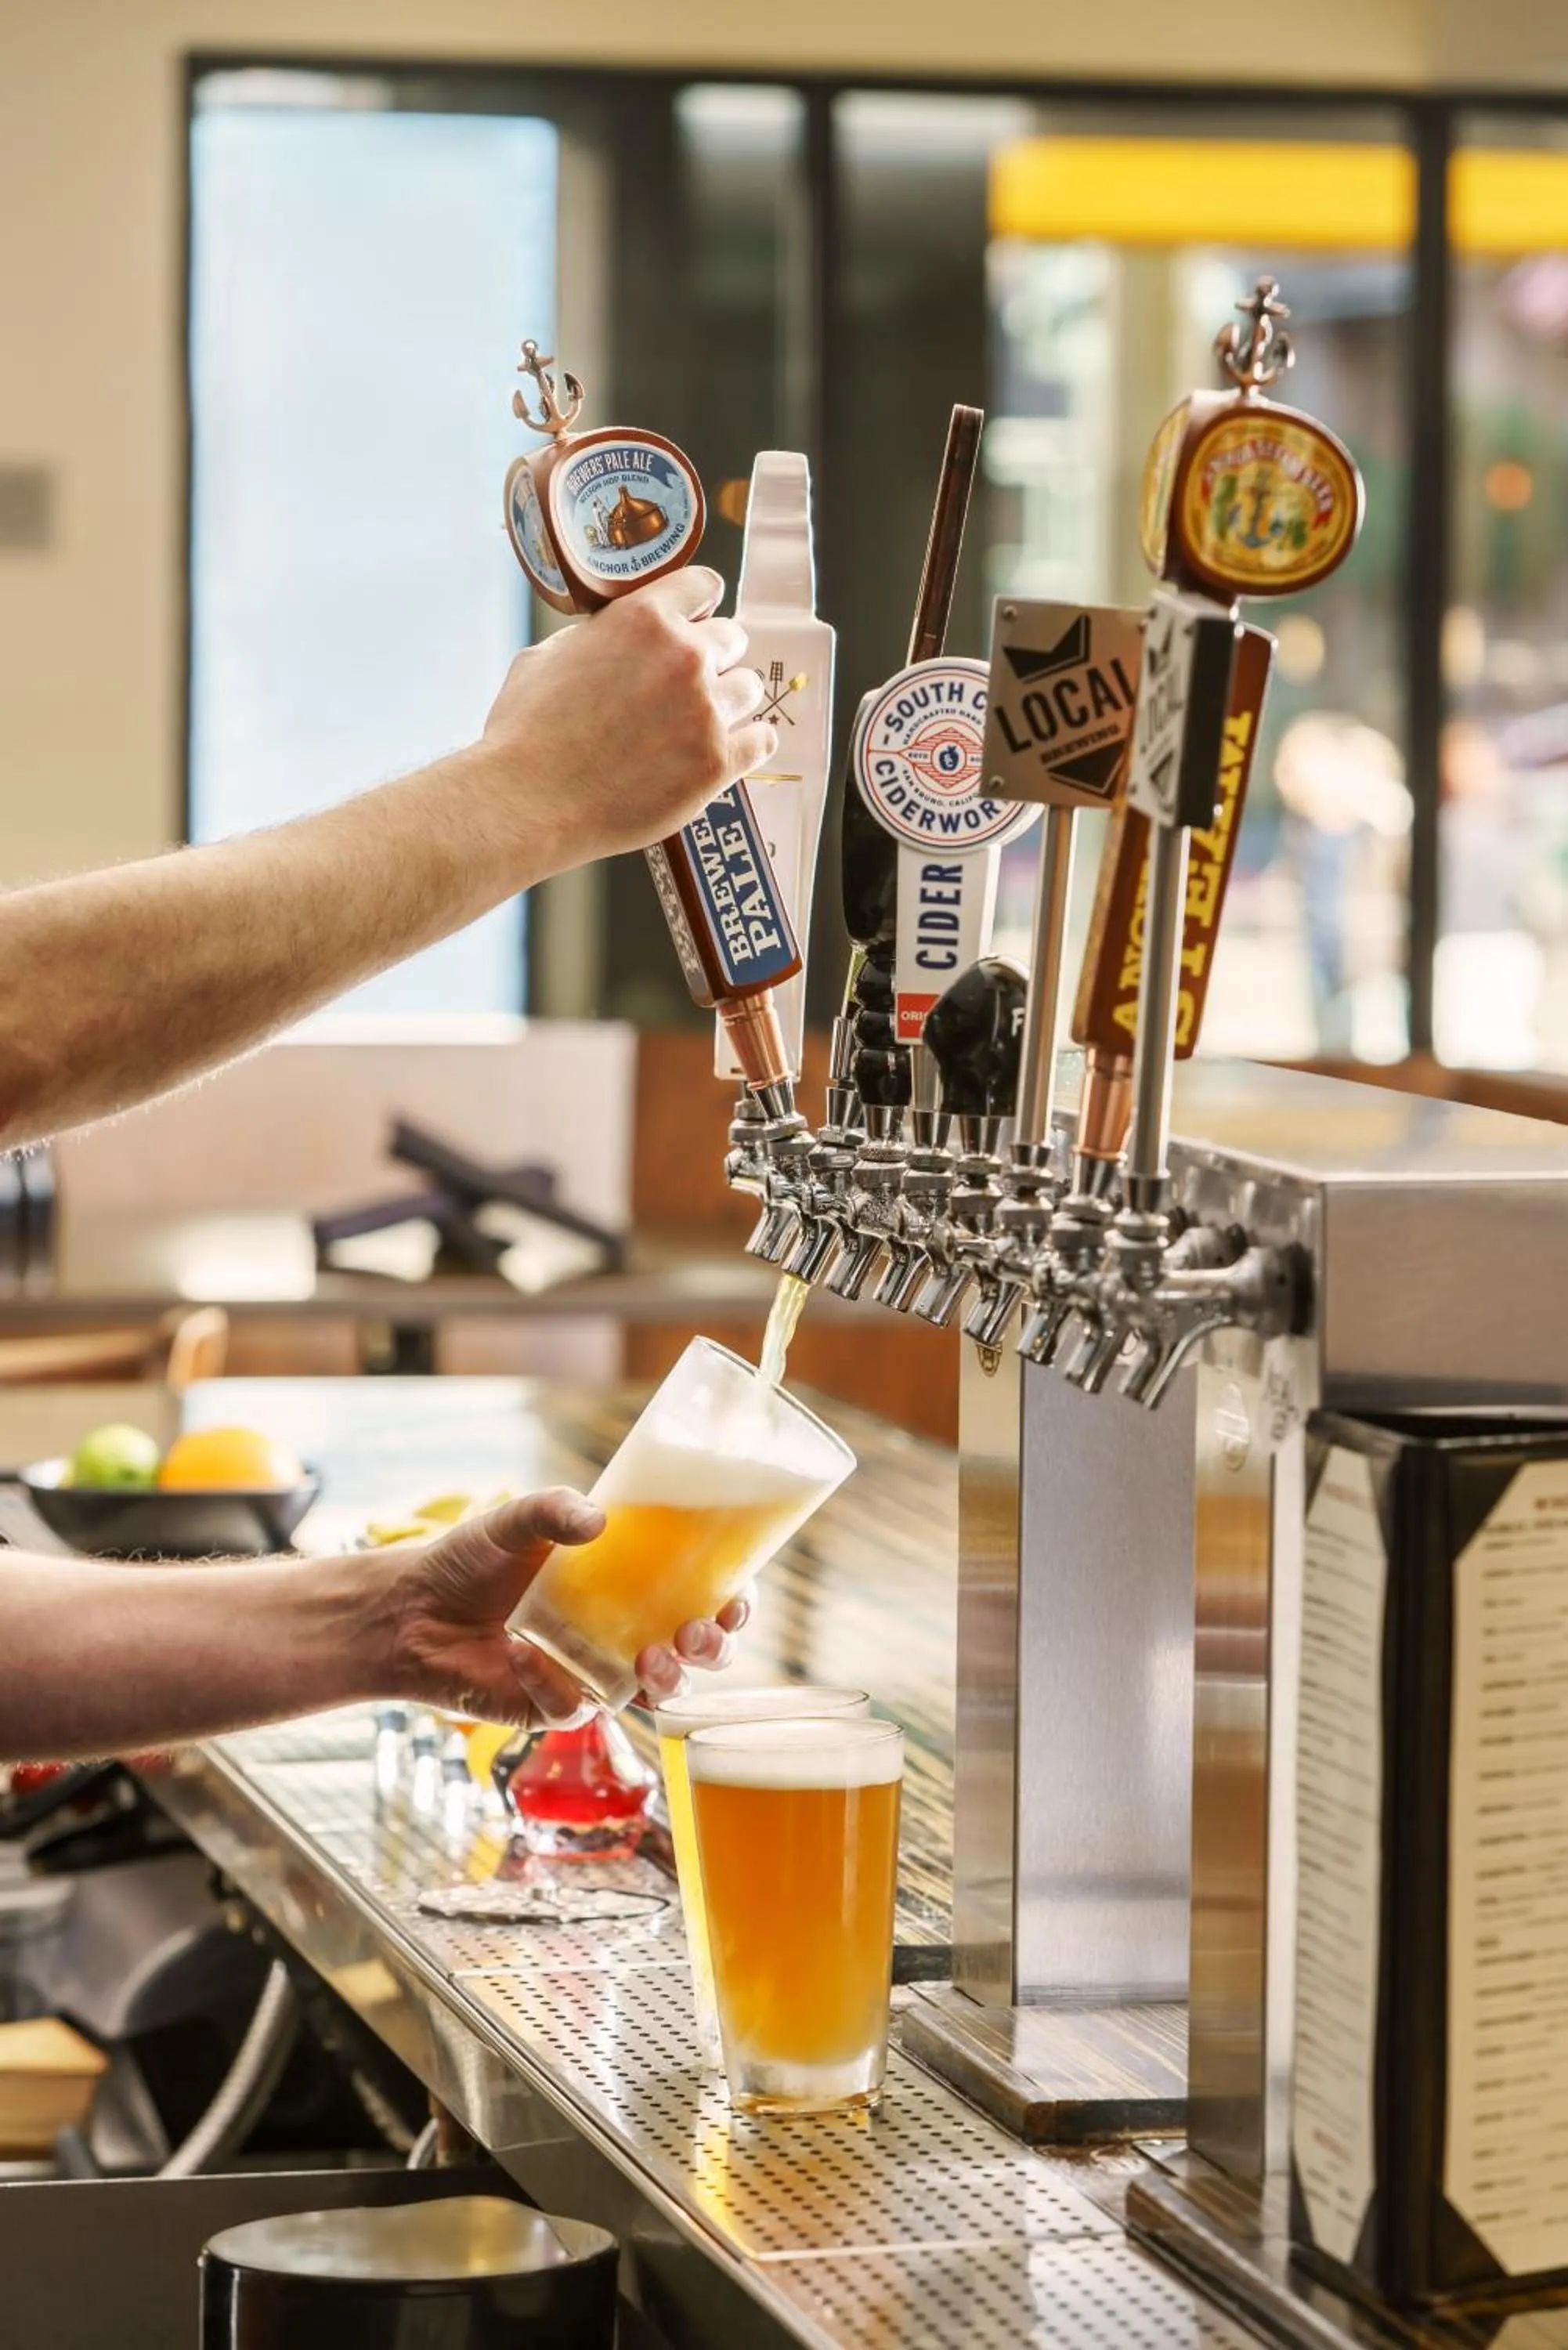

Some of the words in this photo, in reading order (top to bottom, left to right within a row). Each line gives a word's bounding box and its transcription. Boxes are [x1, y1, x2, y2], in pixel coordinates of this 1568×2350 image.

[604, 450, 631, 472] PALE
[632, 450, 655, 472] ALE
[640, 522, 686, 566] BREWING
[883, 681, 965, 733] SOUTH
[875, 758, 1010, 834] CIDERWOR
[690, 809, 753, 966] BREWE
[716, 820, 782, 958] PALE
[915, 863, 963, 971] CIDER
